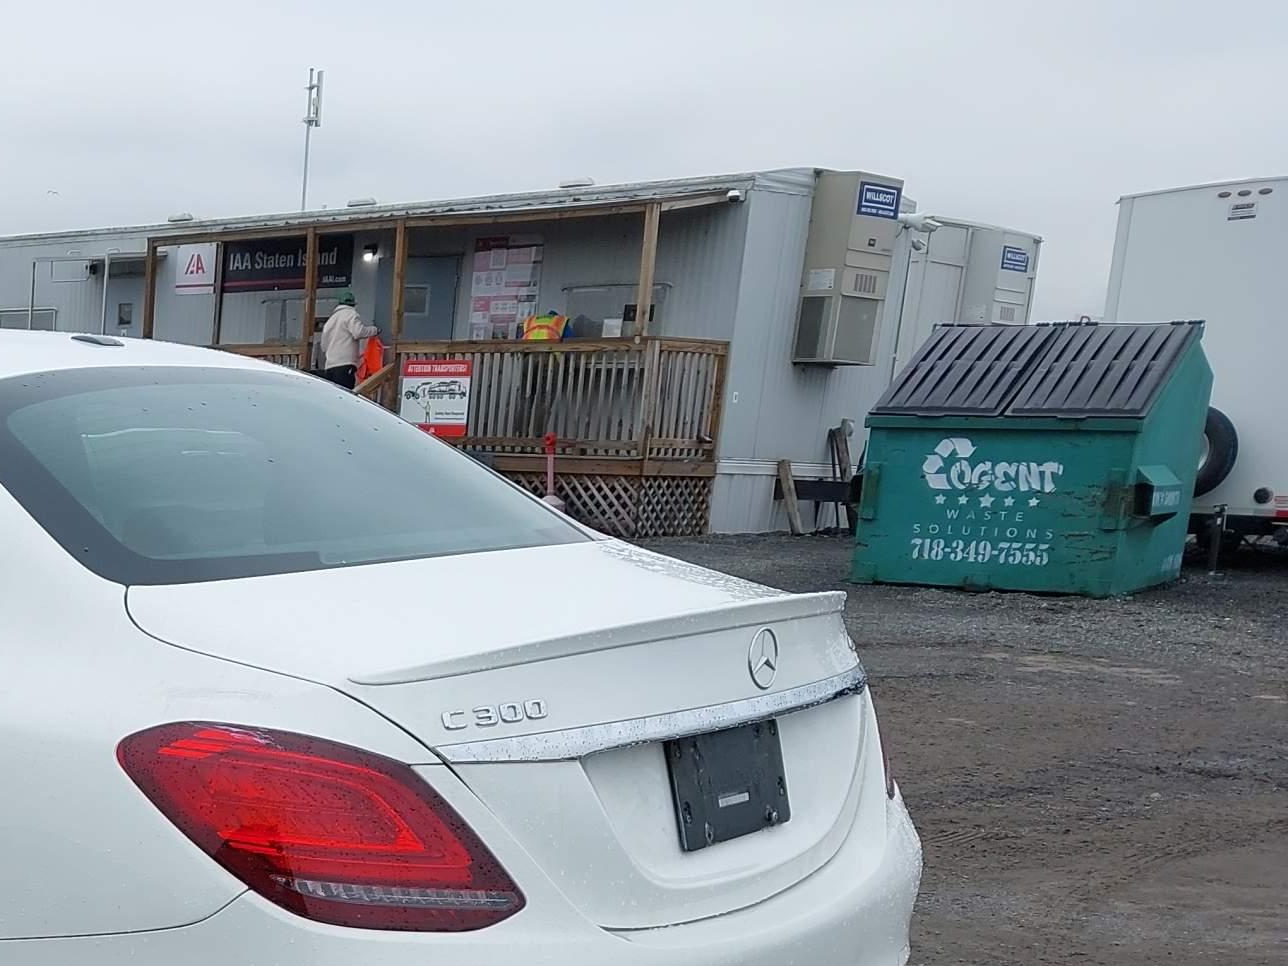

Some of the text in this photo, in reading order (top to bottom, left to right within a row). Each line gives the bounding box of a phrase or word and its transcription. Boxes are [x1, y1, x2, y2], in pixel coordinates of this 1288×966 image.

[866, 191, 894, 204] WILLSCOT
[229, 251, 252, 271] IAA
[255, 252, 294, 269] Staten
[408, 364, 431, 373] ATTENTION
[946, 509, 1024, 522] WASTE
[913, 523, 1054, 540] SOLUTIONS
[911, 538, 1049, 565] 718-349-7555
[441, 699, 548, 730] C 300
